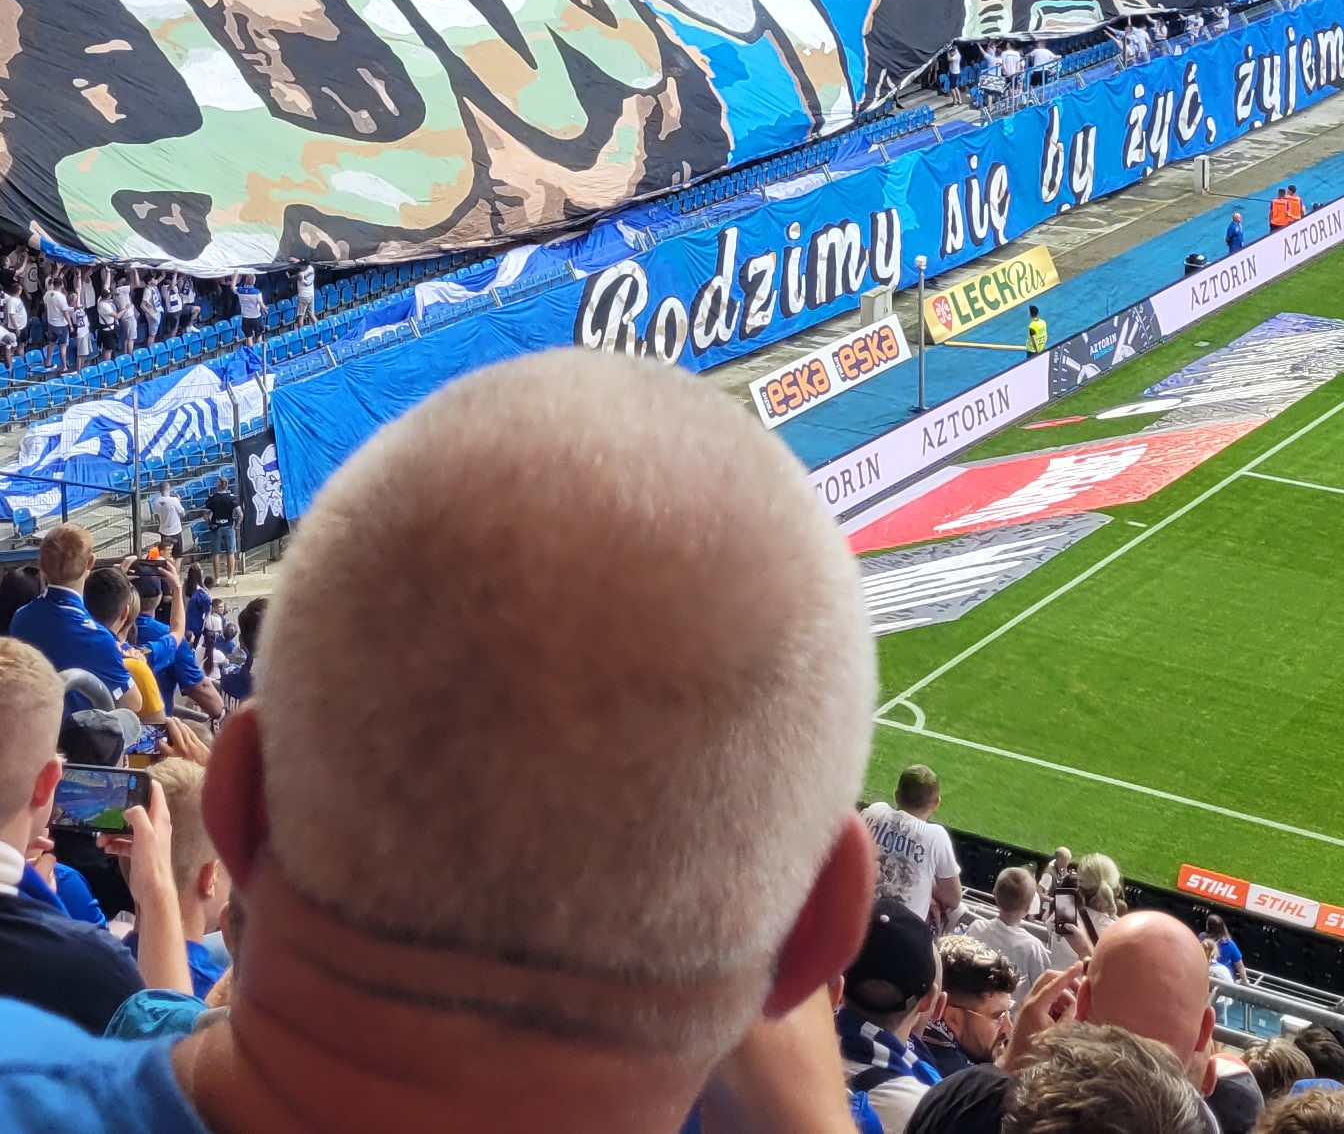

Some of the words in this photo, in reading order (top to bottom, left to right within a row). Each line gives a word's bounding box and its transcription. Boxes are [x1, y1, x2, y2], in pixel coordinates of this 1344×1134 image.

[580, 207, 902, 367] Rodzimy
[943, 155, 1011, 256] się
[1041, 105, 1097, 212] by
[1124, 62, 1217, 176] żyć,
[1283, 209, 1342, 261] AZTORIN
[949, 266, 1017, 325] LECH
[1007, 260, 1047, 299] Pils
[1190, 254, 1257, 311] AZTORIN
[837, 324, 899, 381] eska
[1090, 332, 1117, 357] AZTORIN
[766, 358, 831, 415] eska
[922, 384, 1010, 456] AZTORIN
[815, 452, 880, 505] ORIN
[1186, 874, 1238, 900] STIHL
[1254, 893, 1307, 918] STIHL
